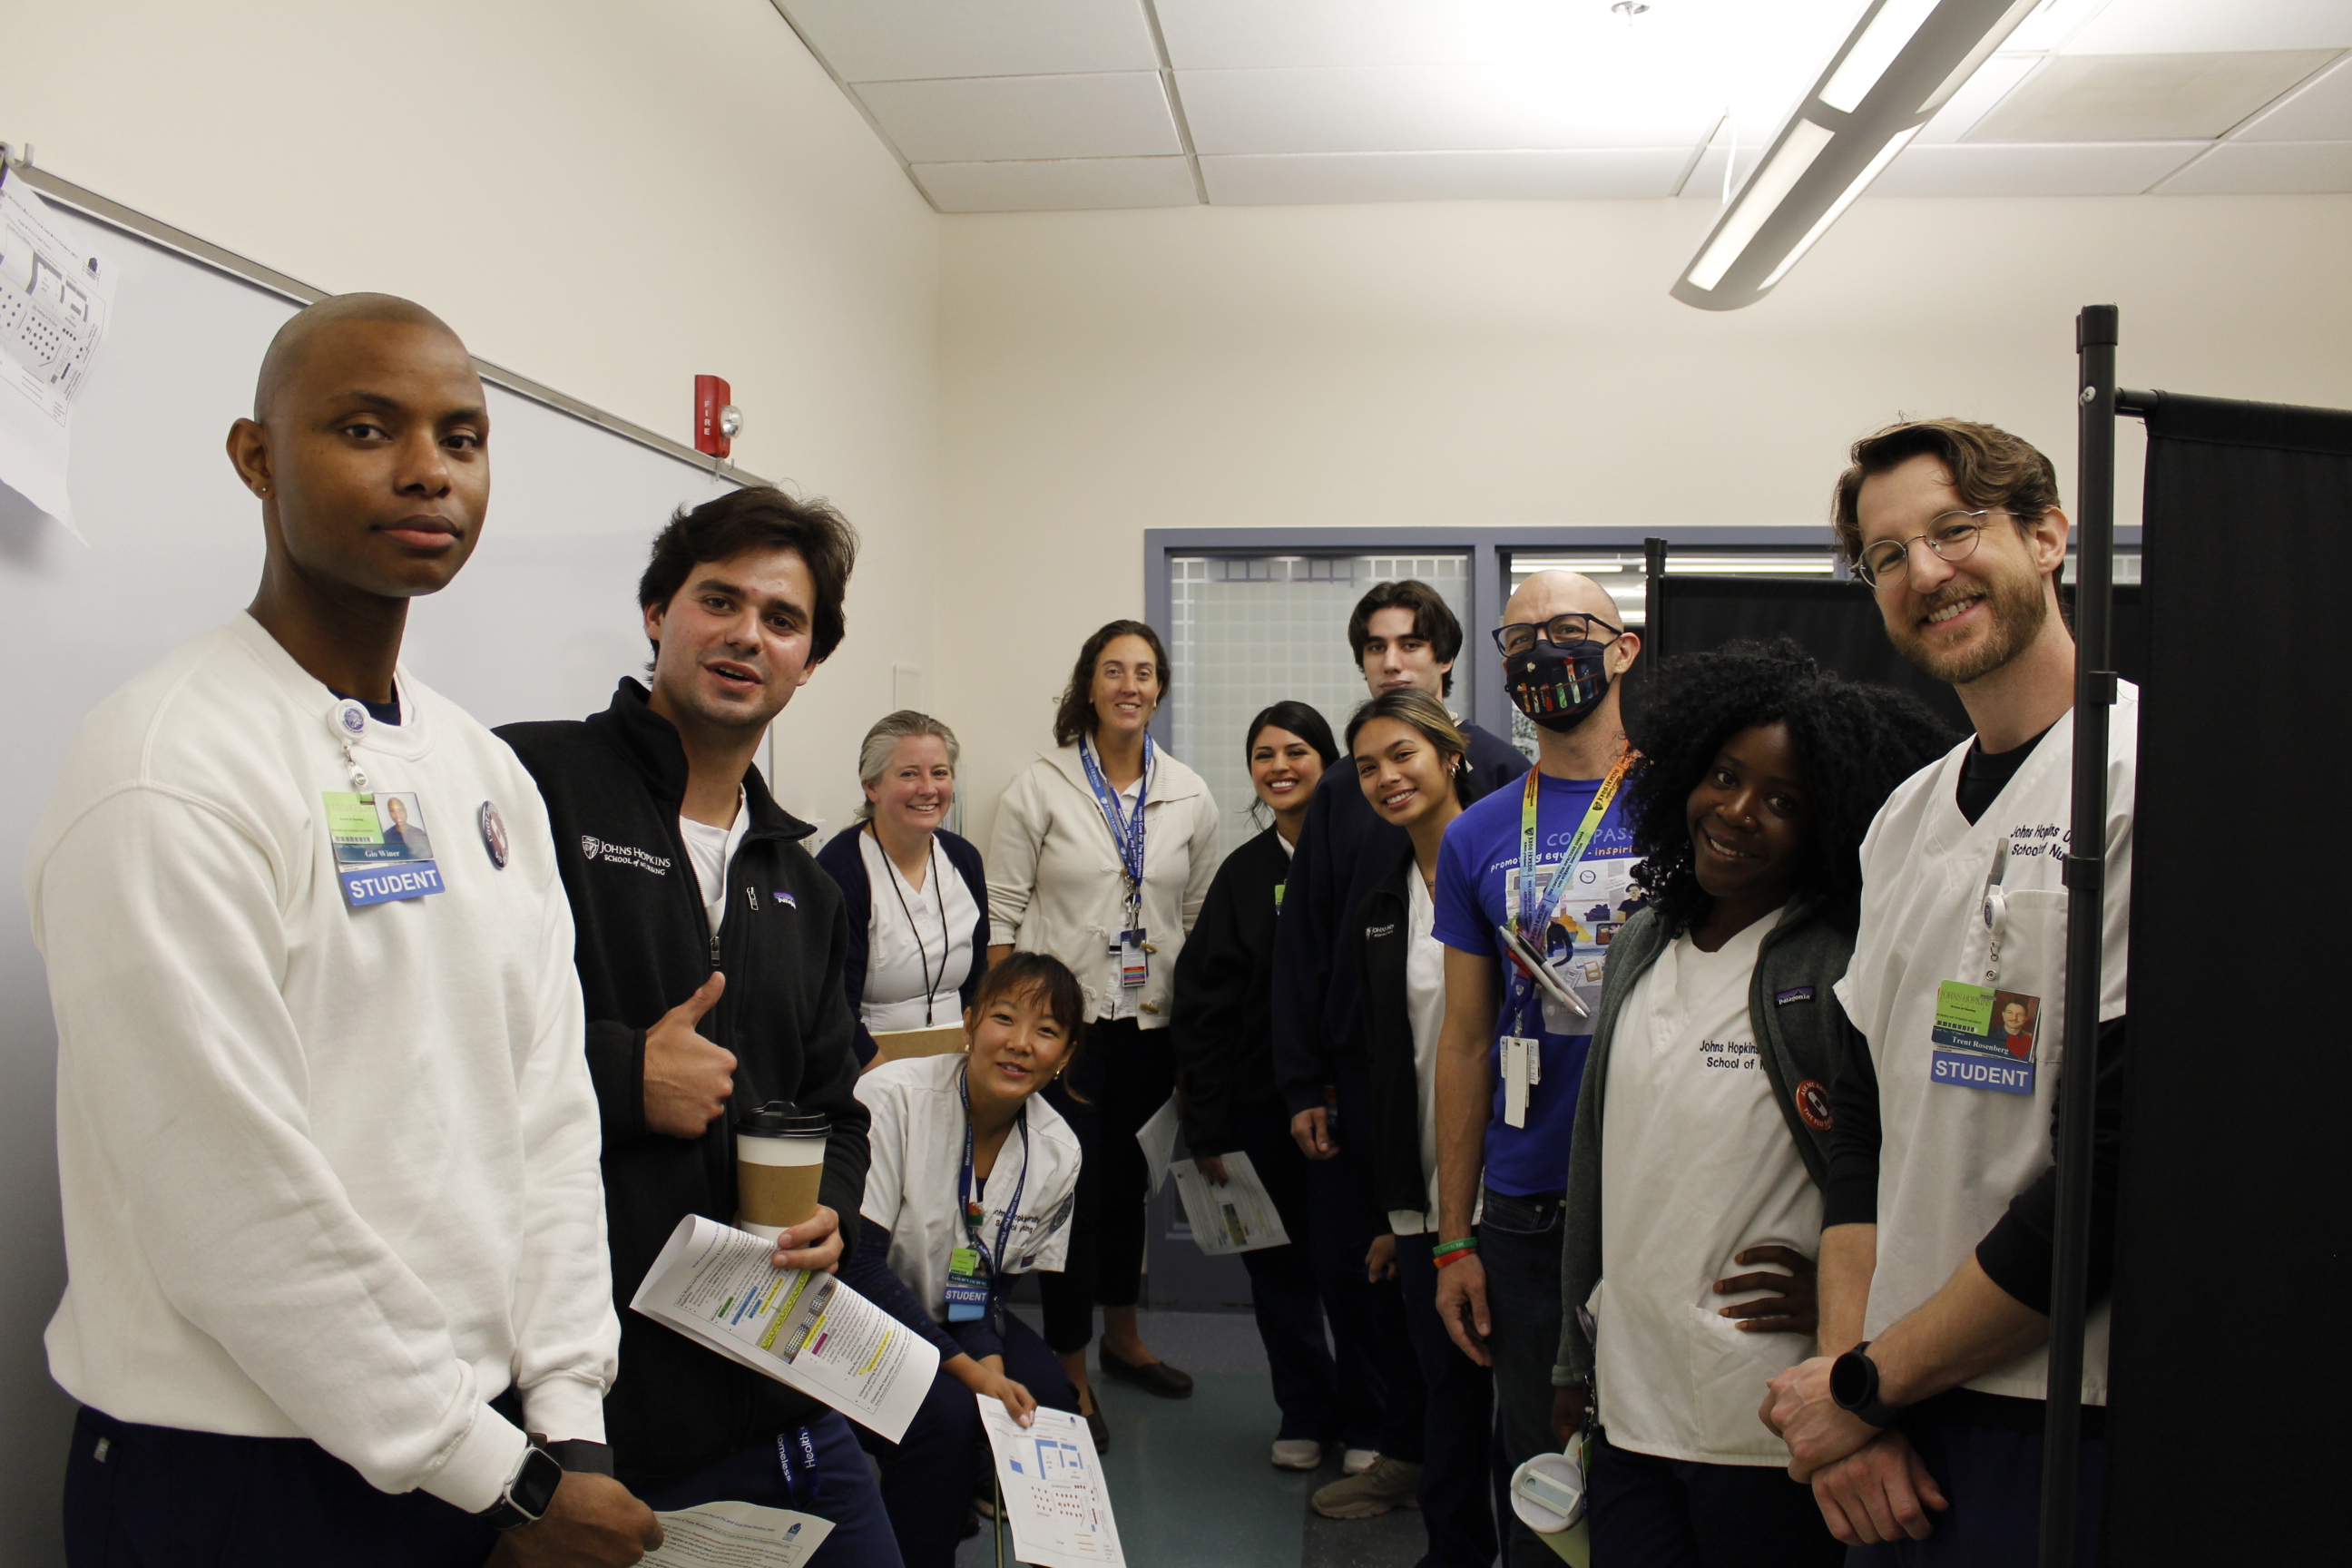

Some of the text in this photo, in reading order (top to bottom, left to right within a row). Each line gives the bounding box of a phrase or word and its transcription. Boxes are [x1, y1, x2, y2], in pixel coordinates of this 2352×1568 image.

[600, 840, 671, 867] JOHNS HOPKINS
[1562, 845, 1577, 867] INFECTIOUS
[1573, 830, 1585, 846] DISEASE
[604, 854, 632, 865] SCHOOL
[1526, 851, 1535, 872] HOPKINS
[350, 869, 437, 898] STUDENT
[1779, 993, 1810, 1005] patagonia
[1700, 1040, 1759, 1056] Johns Hopkins
[1953, 1036, 1971, 1045] Trent
[1973, 1040, 2009, 1055] Rosenberg
[1707, 1056, 1739, 1069] School
[1744, 1058, 1755, 1069] of
[1936, 1060, 2029, 1087] STUDENT
[1804, 1108, 1813, 1121] THE
[1007, 1200, 1016, 1218] Care
[946, 1290, 987, 1301] STUDENT
[799, 1432, 816, 1468] Health
